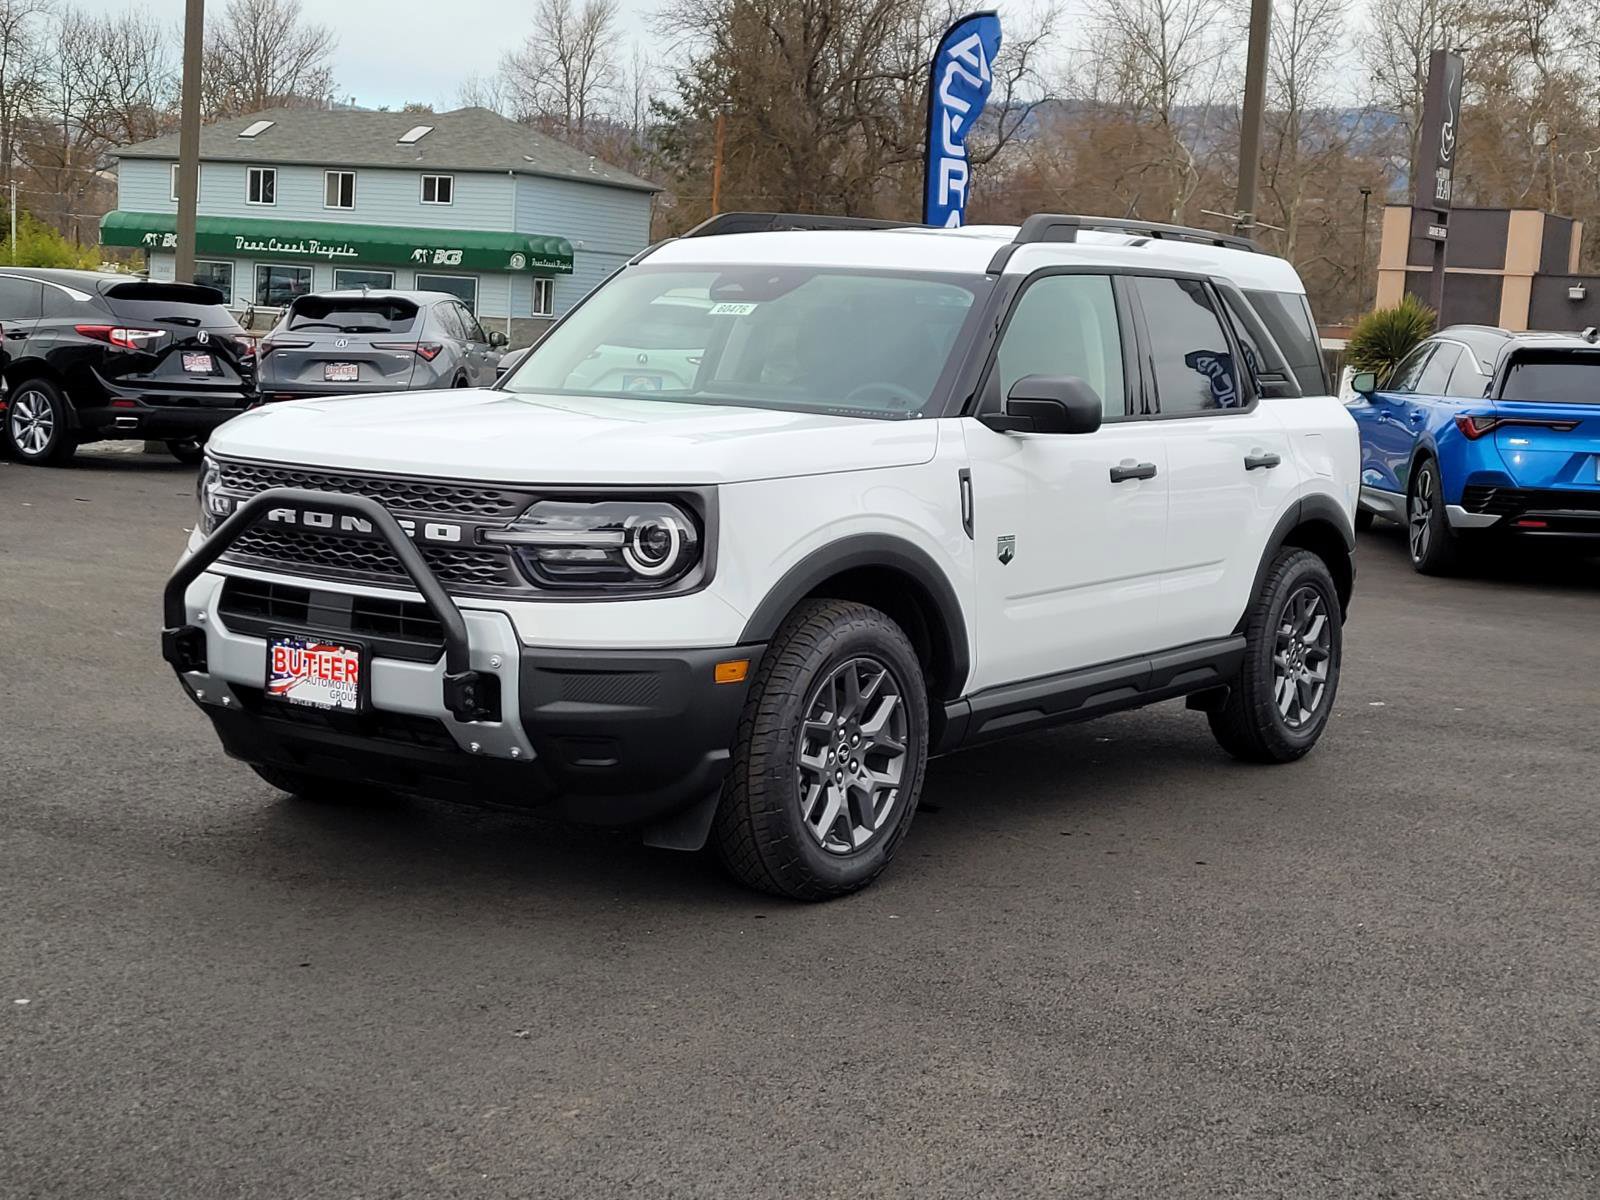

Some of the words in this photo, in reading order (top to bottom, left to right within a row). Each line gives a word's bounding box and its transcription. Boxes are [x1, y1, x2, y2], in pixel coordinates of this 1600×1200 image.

[235, 236, 268, 250] Bear
[268, 238, 309, 253] Creek
[308, 240, 359, 259] Bicycle
[433, 249, 463, 265] BCB
[273, 647, 358, 684] BUTLER
[305, 676, 358, 692] AUTOMOTIVE
